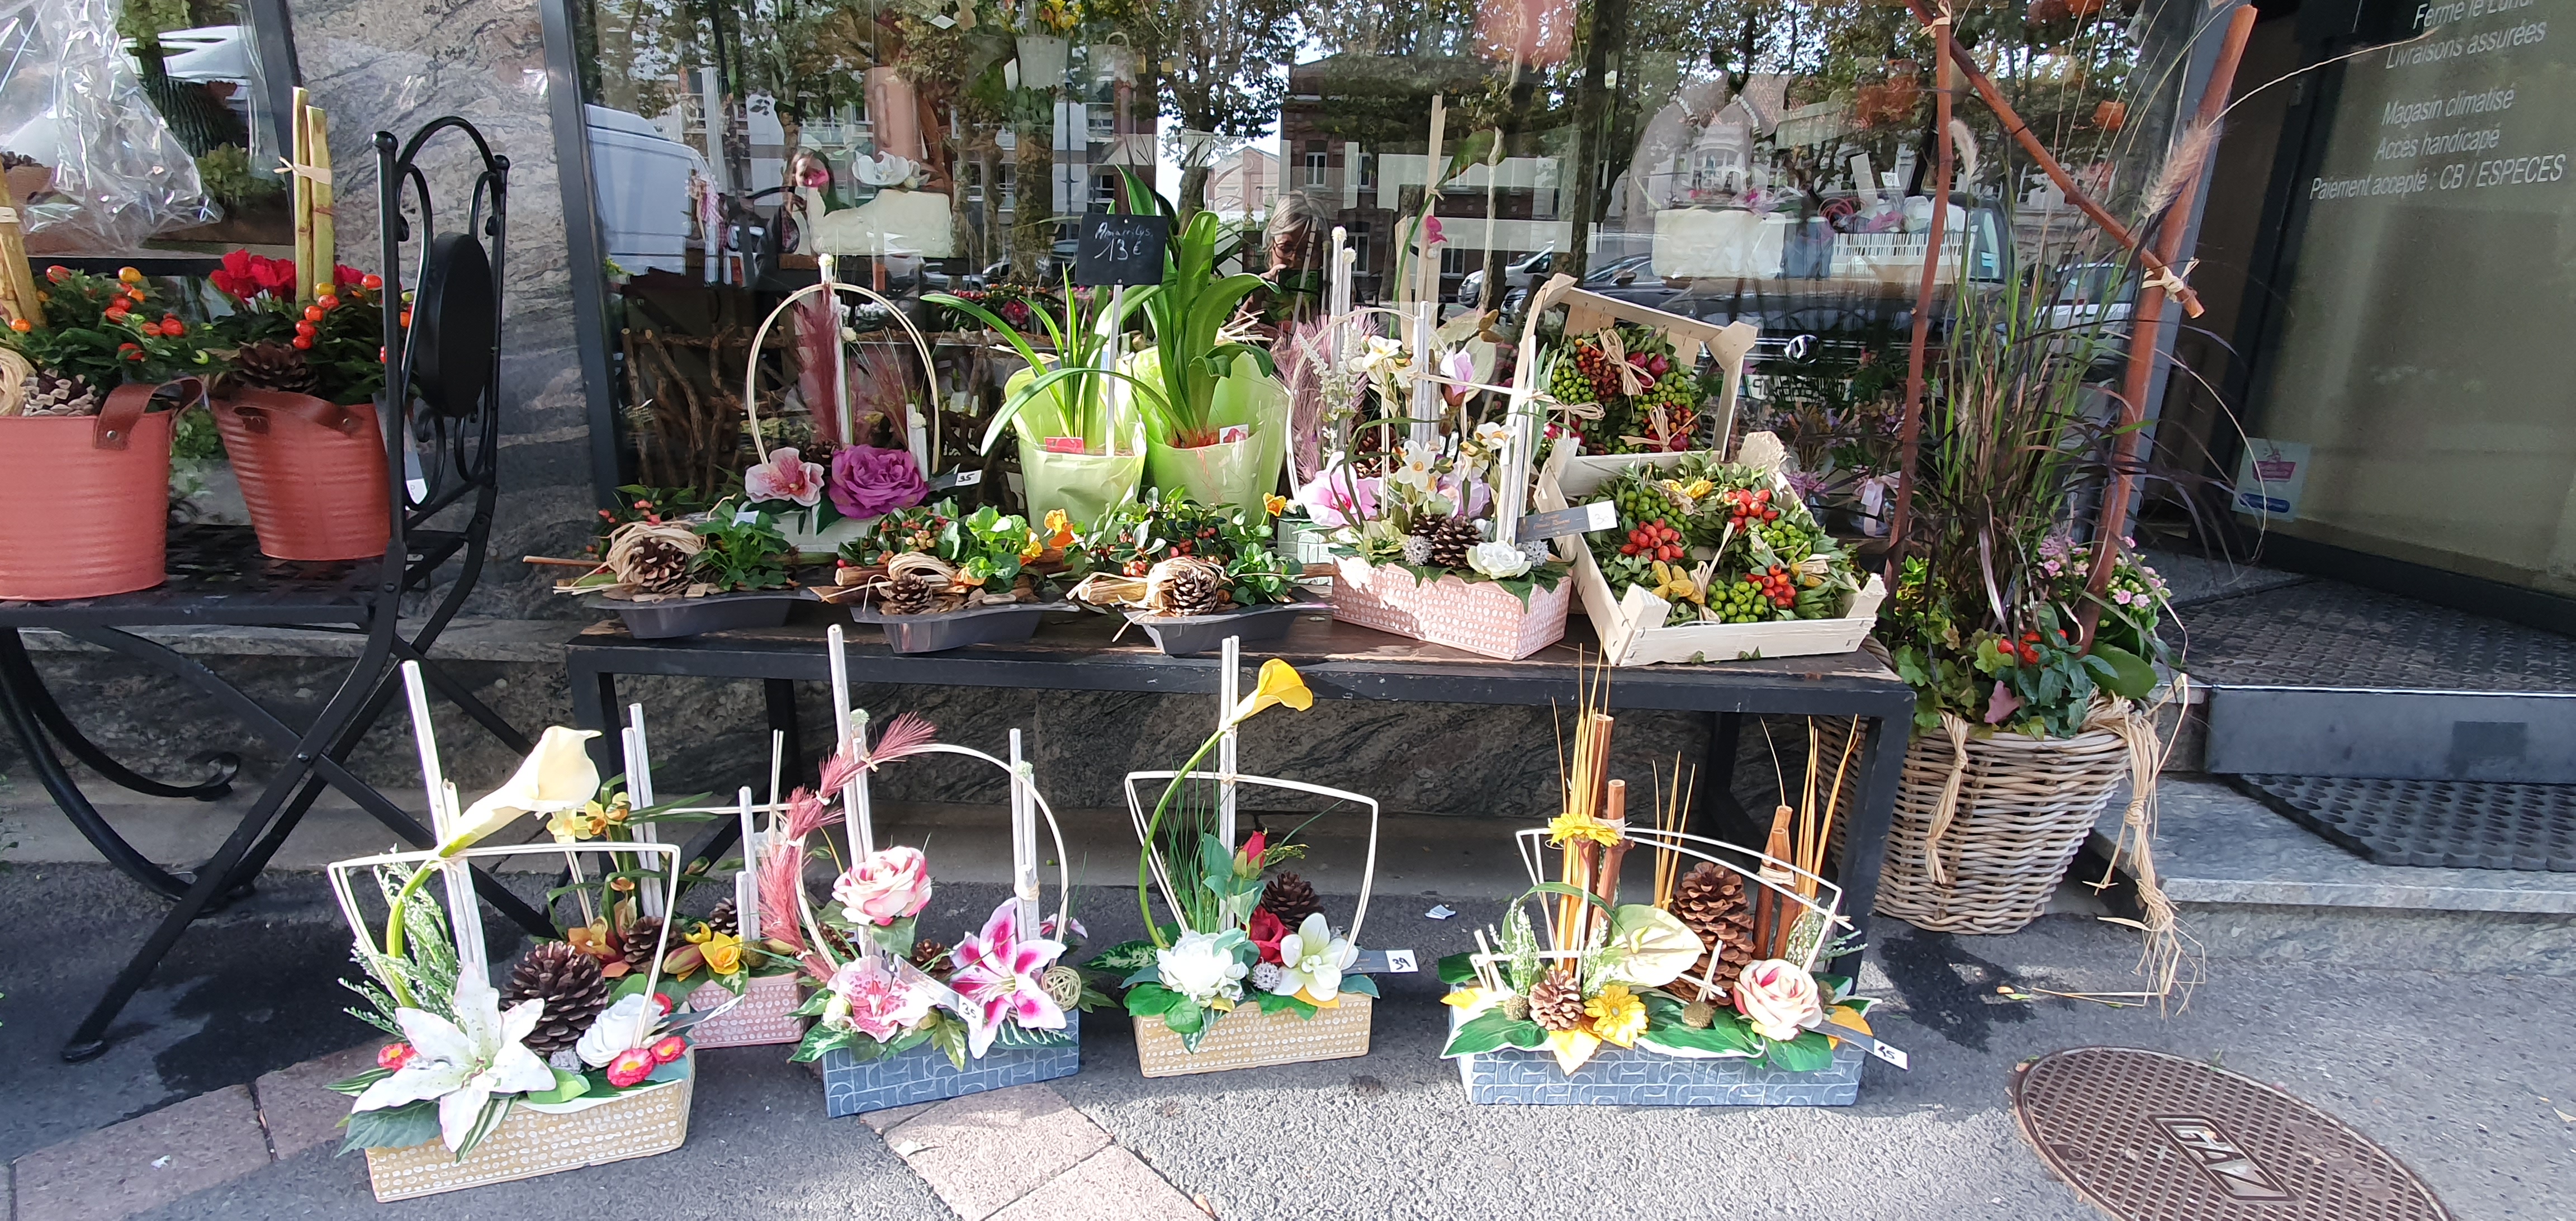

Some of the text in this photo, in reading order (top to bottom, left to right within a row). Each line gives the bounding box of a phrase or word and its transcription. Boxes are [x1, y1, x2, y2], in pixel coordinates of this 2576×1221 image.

[2385, 18, 2547, 69] Livraisons assurées
[2381, 82, 2515, 129] Magasin climatisé
[2373, 122, 2501, 161] Accès handicapé
[2309, 174, 2373, 200] Paiement
[2371, 167, 2428, 199] accepté
[2439, 163, 2465, 190] CB
[2475, 153, 2567, 188] ESPECES
[1392, 957, 1411, 971] 39
[962, 1002, 977, 1019] 35
[2160, 1120, 2285, 1192] GAZ
